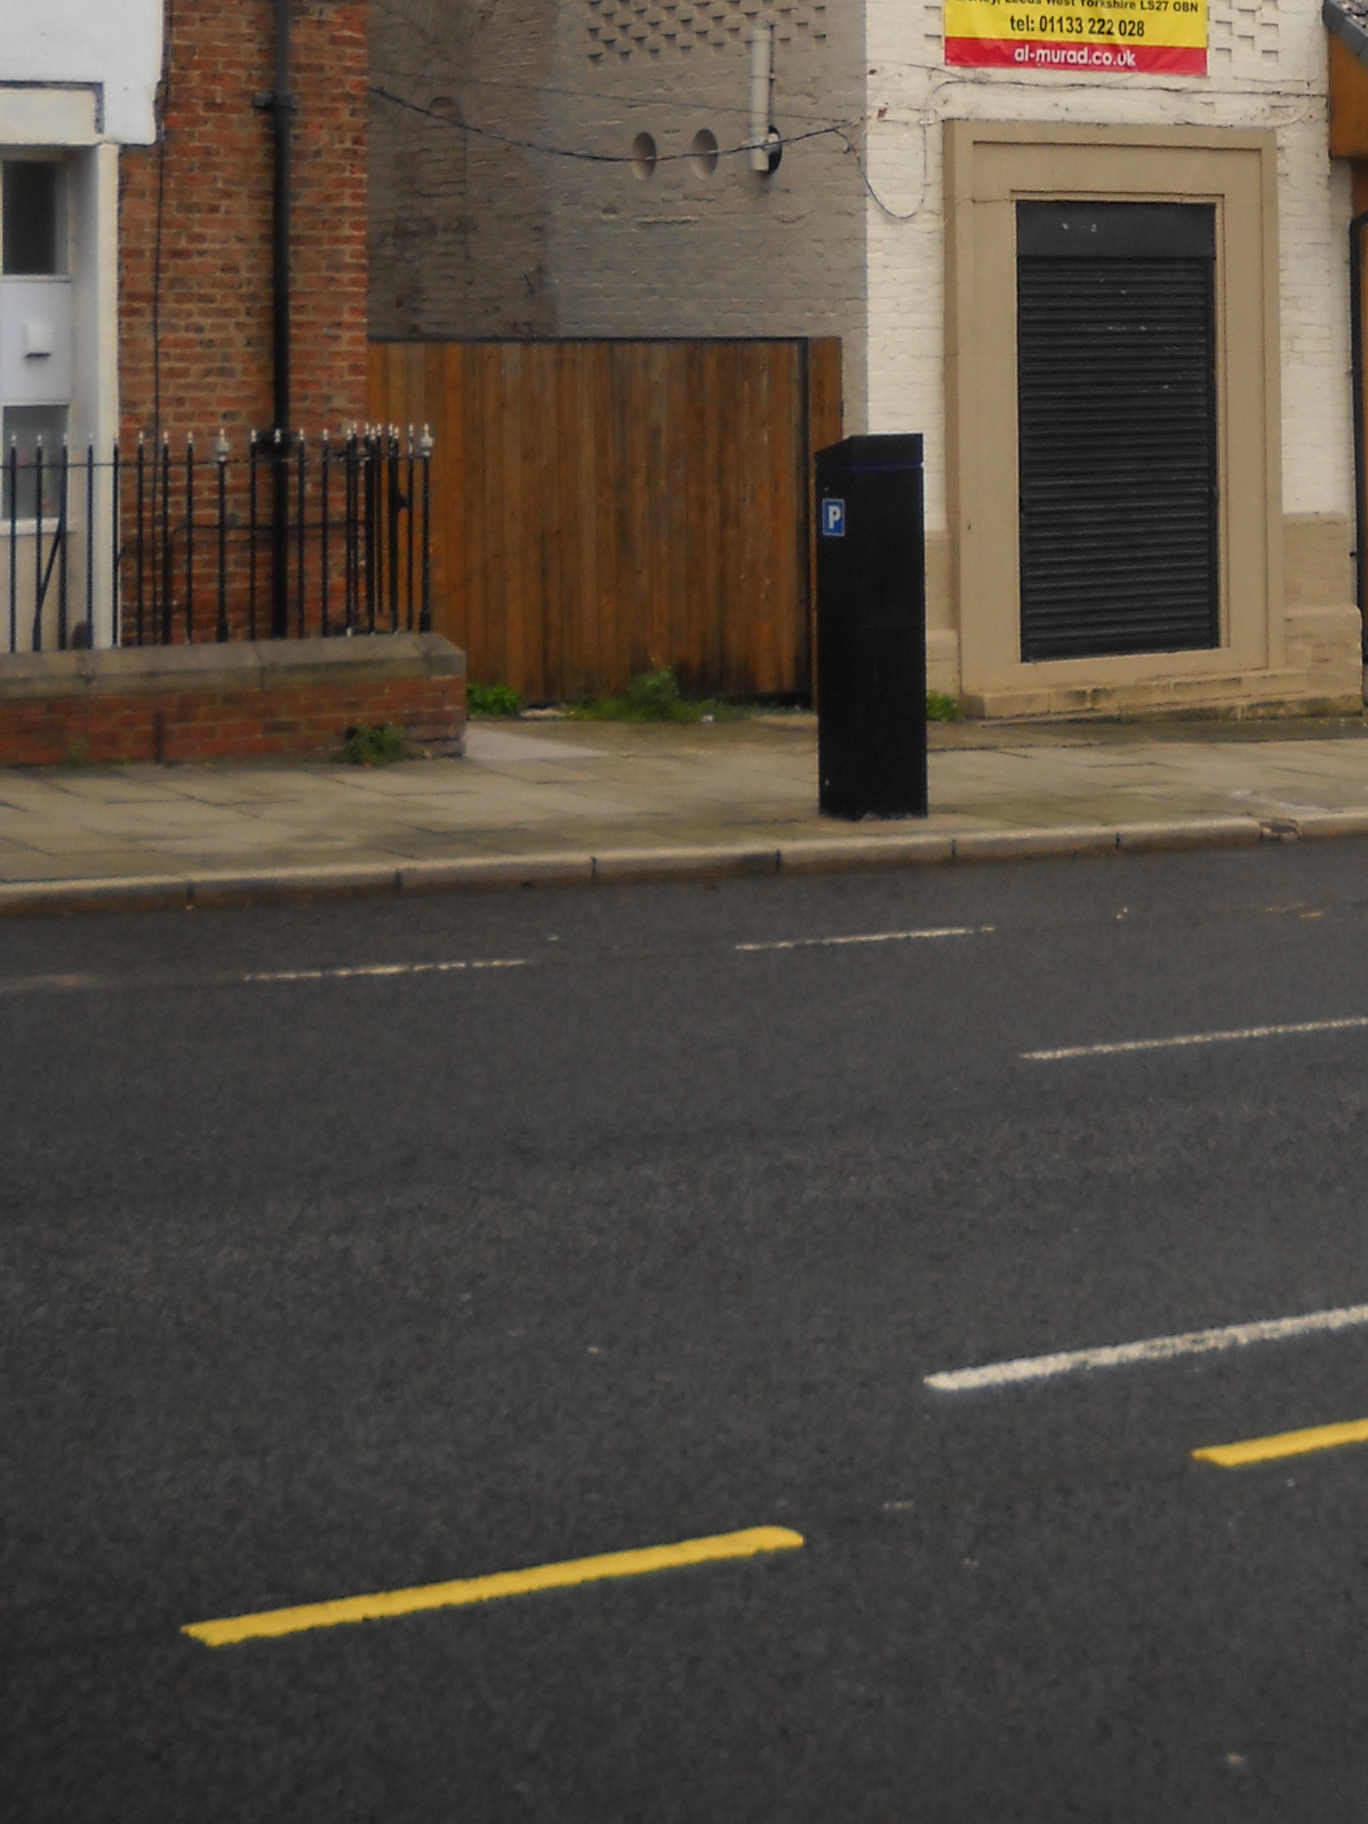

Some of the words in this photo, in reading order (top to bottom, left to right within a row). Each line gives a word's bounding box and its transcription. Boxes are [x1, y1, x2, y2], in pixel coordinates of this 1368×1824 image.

[1140, 0, 1169, 11] LS27
[1010, 14, 1035, 32] tel:
[1039, 15, 1083, 34] 01133
[1088, 18, 1115, 36] 222
[1118, 20, 1145, 37] 028
[1014, 44, 1136, 67] al-murad.co.uk
[828, 505, 841, 529] P
